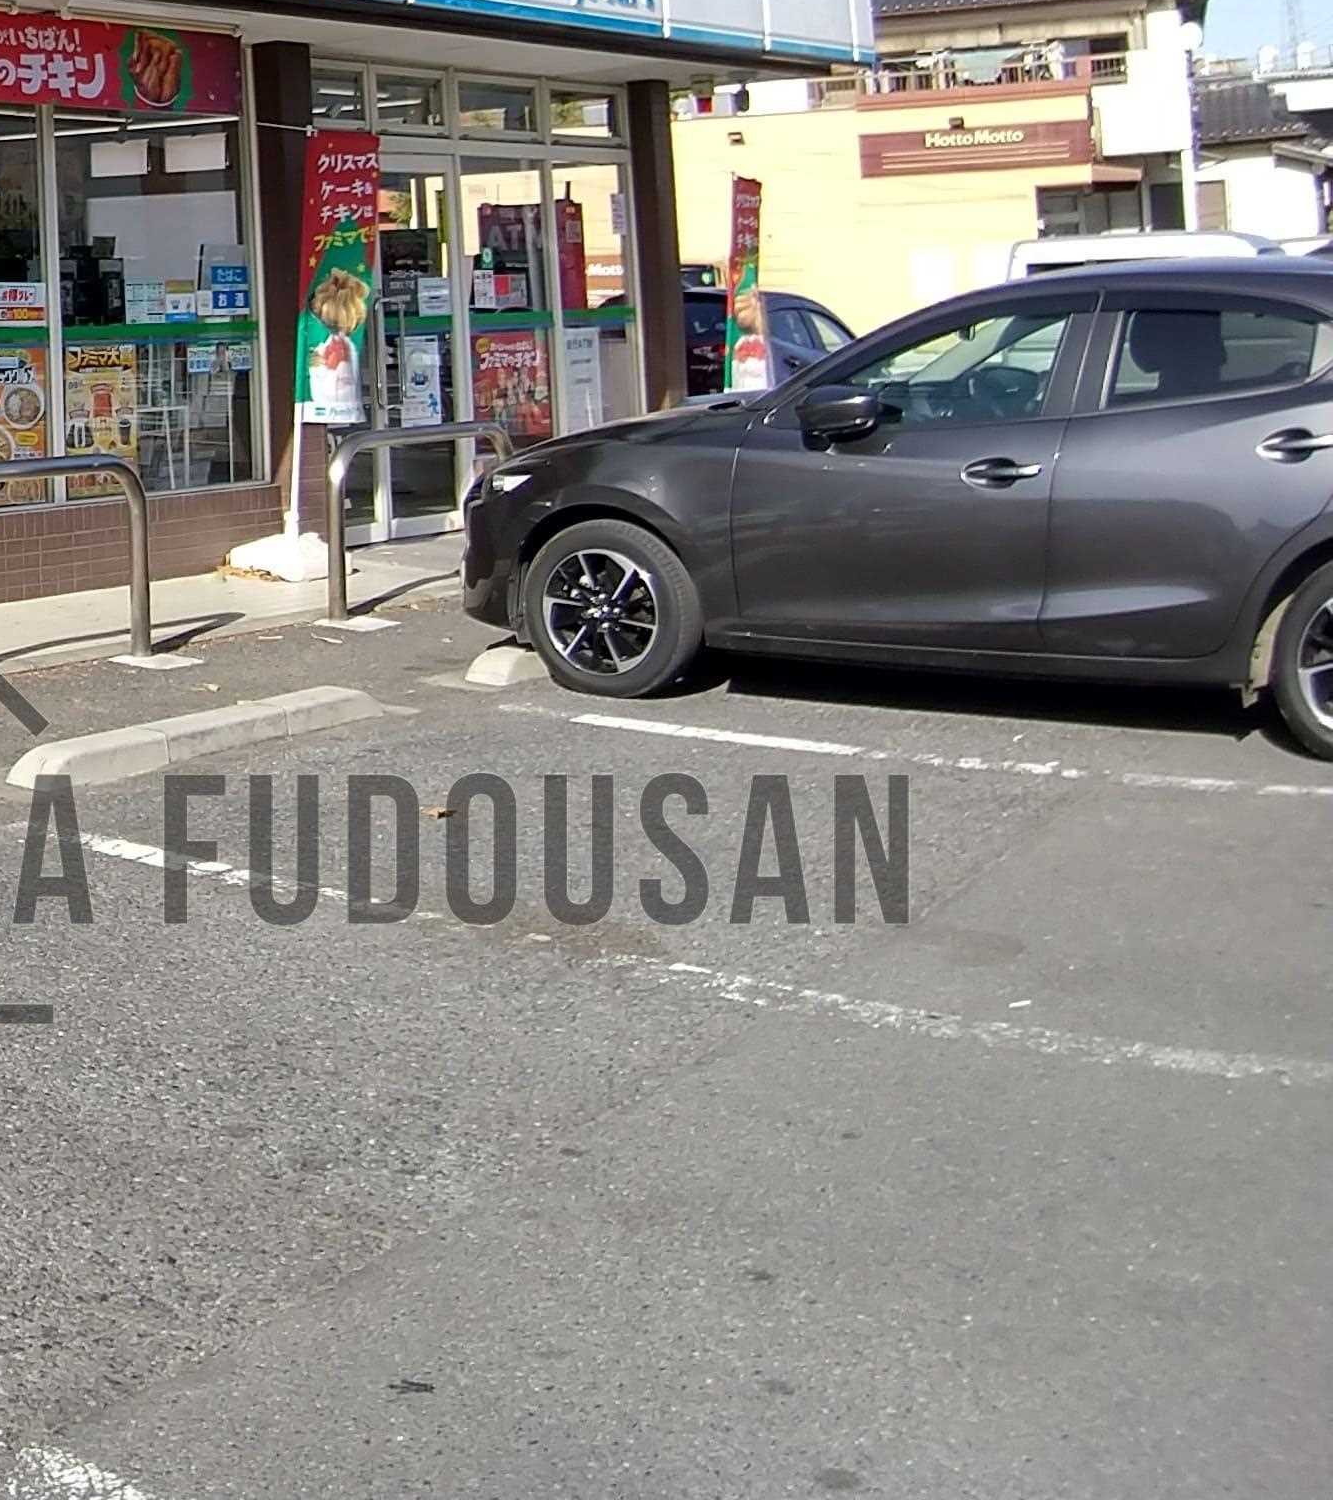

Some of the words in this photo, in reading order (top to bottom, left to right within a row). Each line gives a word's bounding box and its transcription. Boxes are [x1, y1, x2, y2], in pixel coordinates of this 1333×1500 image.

[317, 153, 379, 174] クリスマス
